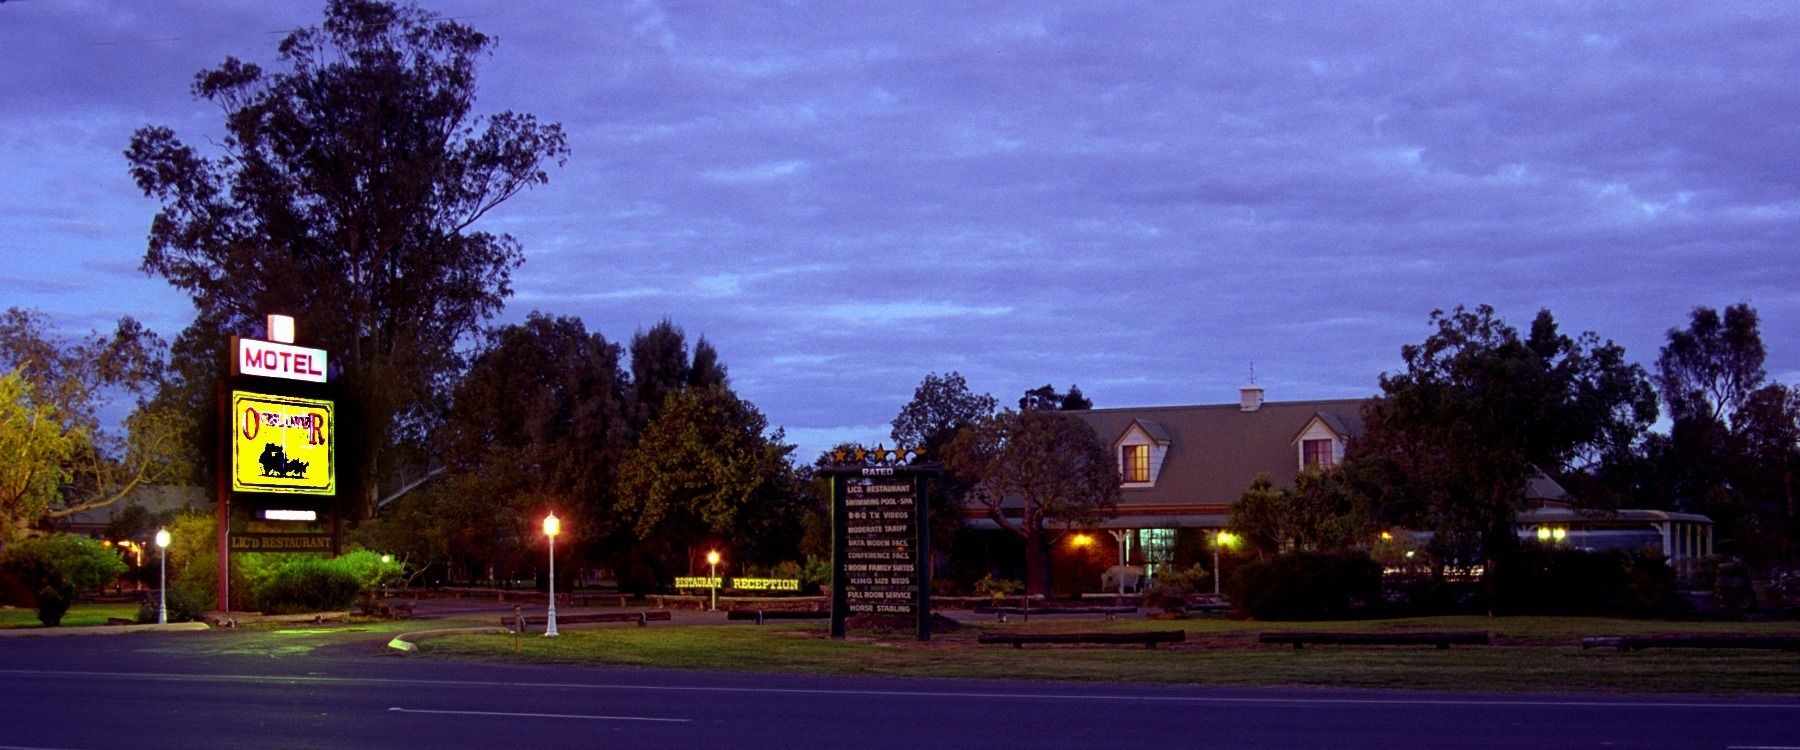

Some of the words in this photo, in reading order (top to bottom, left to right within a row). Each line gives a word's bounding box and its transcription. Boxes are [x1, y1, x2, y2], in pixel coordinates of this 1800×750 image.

[245, 347, 322, 376] MOTEL
[862, 468, 894, 476] RATED
[866, 485, 910, 493] RESTAURANT
[262, 537, 331, 548] RESTAURANT
[675, 578, 722, 588] RESTAURANT
[733, 578, 799, 590] RECEPTION
